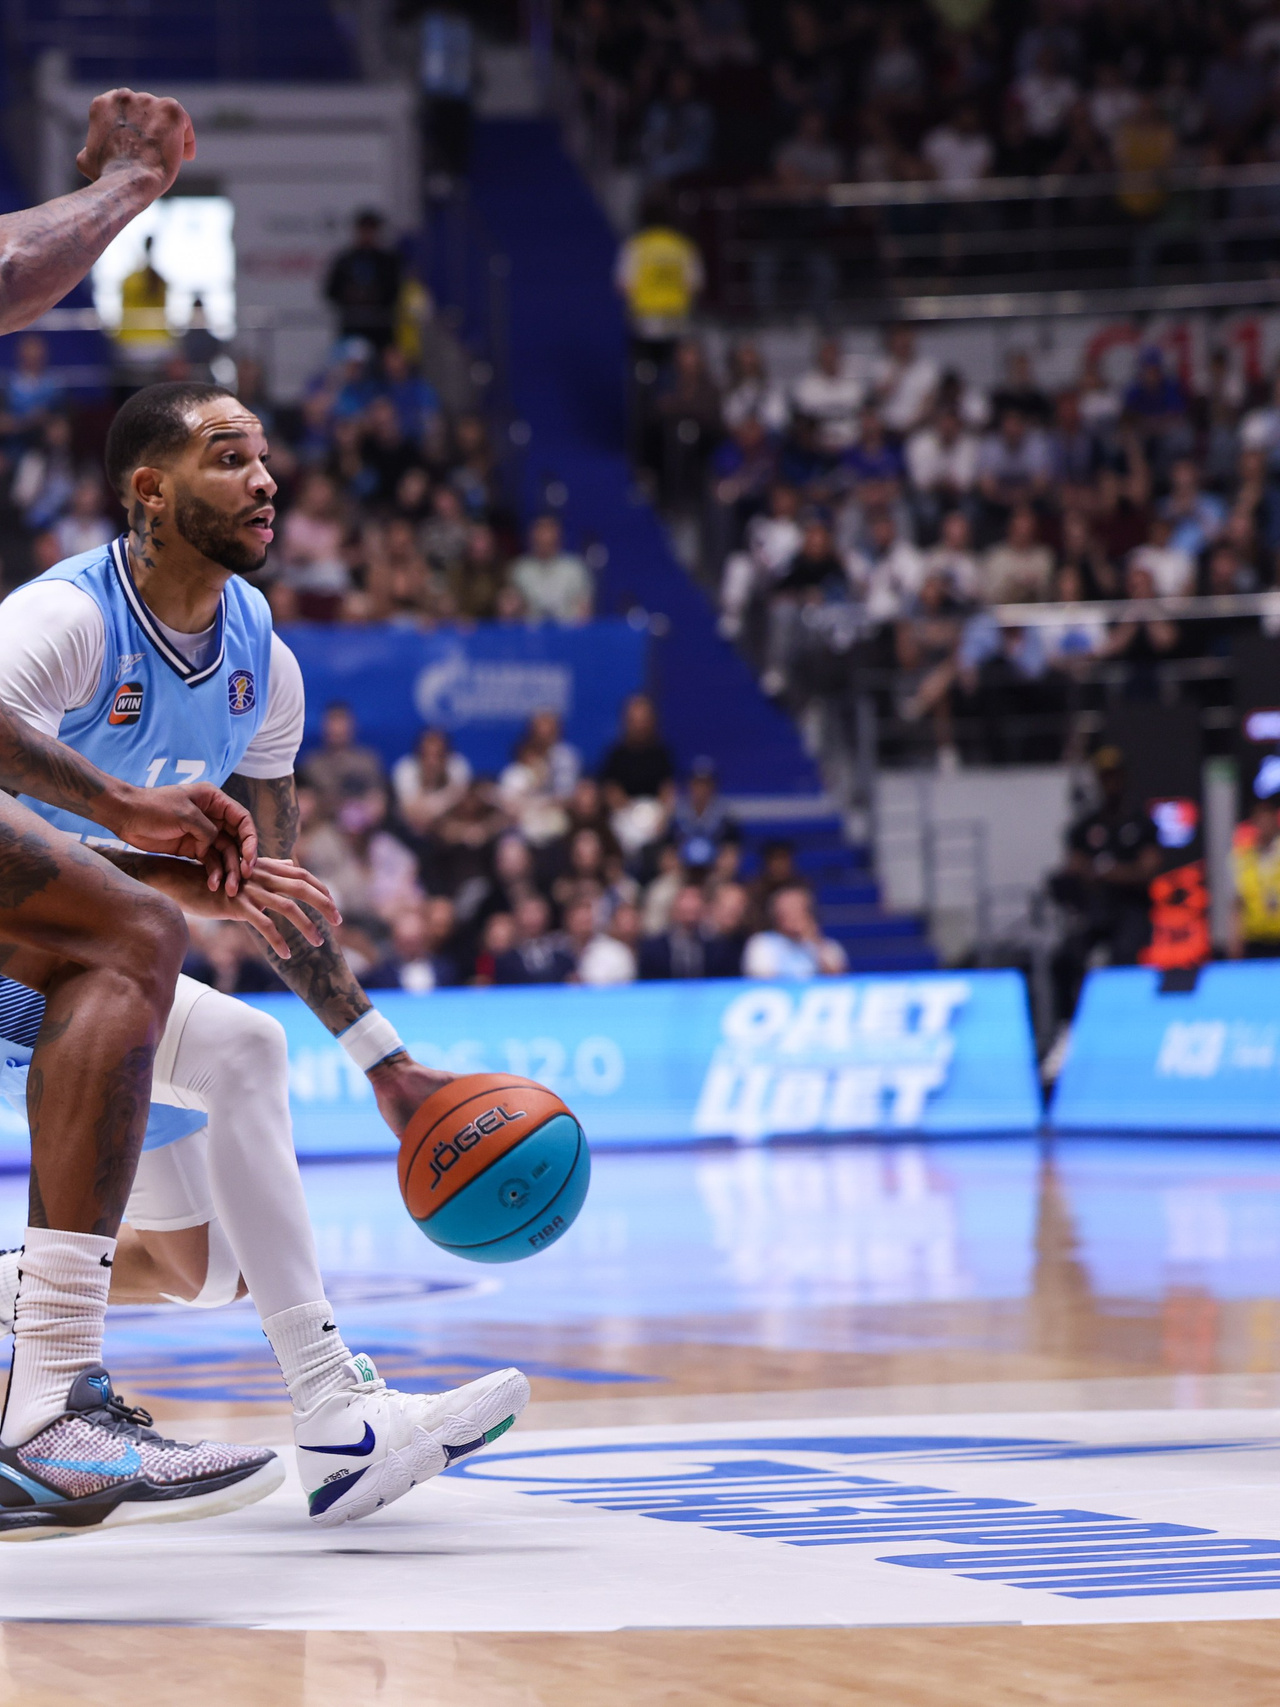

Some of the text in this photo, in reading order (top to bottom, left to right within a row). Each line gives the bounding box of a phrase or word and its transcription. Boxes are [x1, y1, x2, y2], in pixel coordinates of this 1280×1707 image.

[117, 697, 142, 711] WIN
[429, 1105, 527, 1192] JÖGEL
[527, 1215, 564, 1248] FIBA
